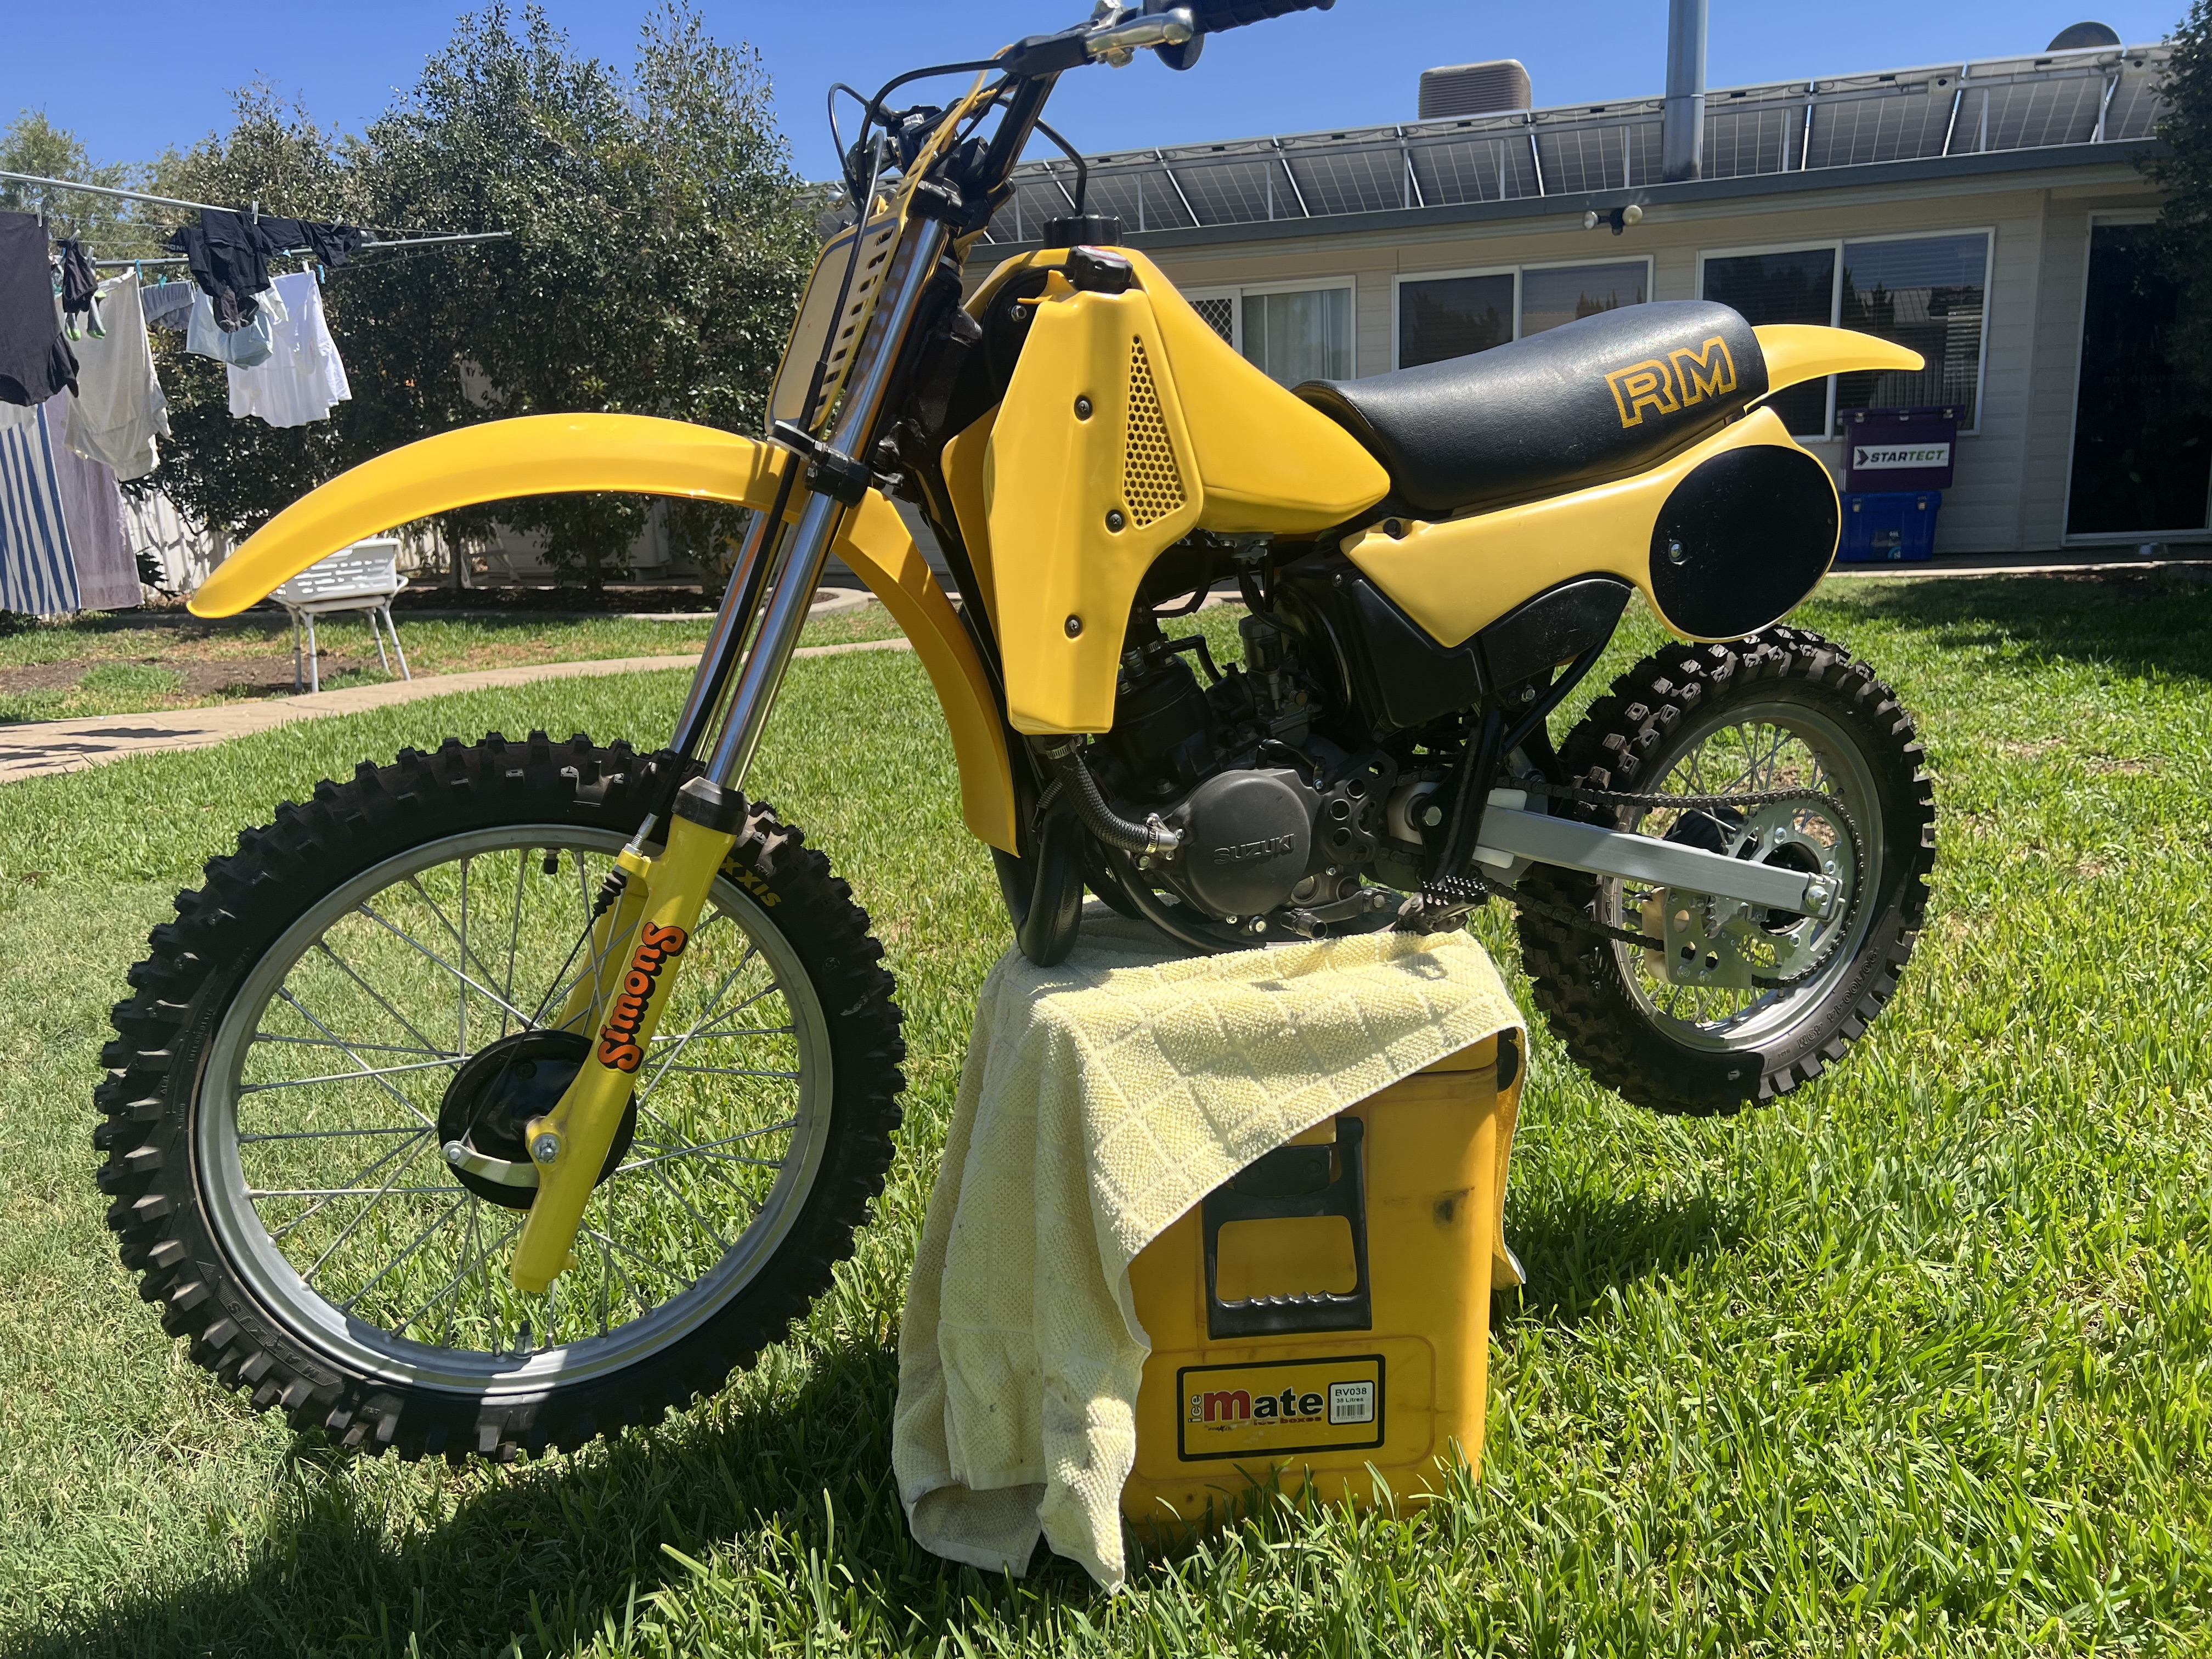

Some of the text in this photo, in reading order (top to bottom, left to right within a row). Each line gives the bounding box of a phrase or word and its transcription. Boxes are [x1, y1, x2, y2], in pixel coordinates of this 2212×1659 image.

[1605, 336, 1737, 428] RM
[1871, 450, 1945, 463] STARTECT
[1214, 833, 1295, 865] SUZUKI
[1797, 1022, 1823, 1049] 49M
[228, 1301, 318, 1379] MAXXIS
[1203, 1386, 1324, 1422] mate
[1335, 1387, 1367, 1396] BV038
